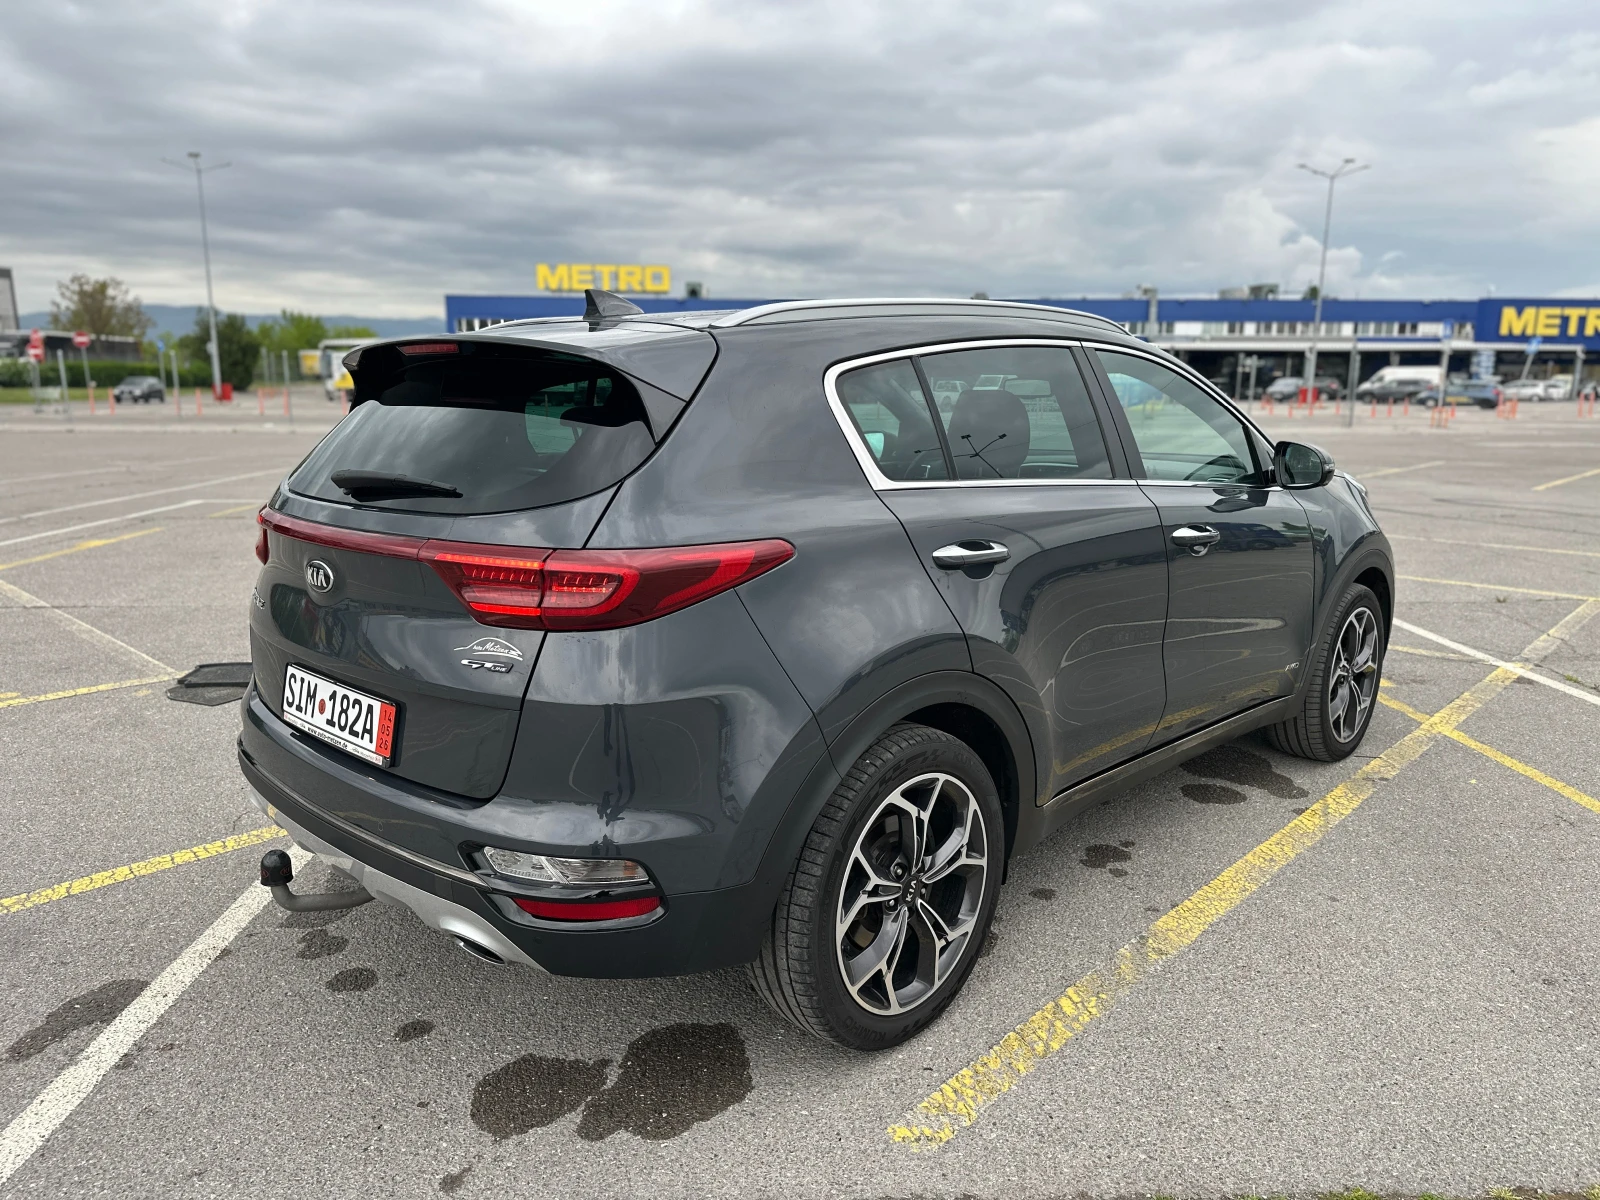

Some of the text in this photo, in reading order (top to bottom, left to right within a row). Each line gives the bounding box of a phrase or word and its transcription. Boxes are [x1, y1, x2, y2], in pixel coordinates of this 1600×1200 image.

[536, 263, 671, 292] METRO
[306, 566, 327, 588] KIA
[286, 672, 374, 745] SIM 182A
[383, 709, 392, 724] 14
[380, 723, 390, 737] 05
[905, 880, 917, 902] KIA
